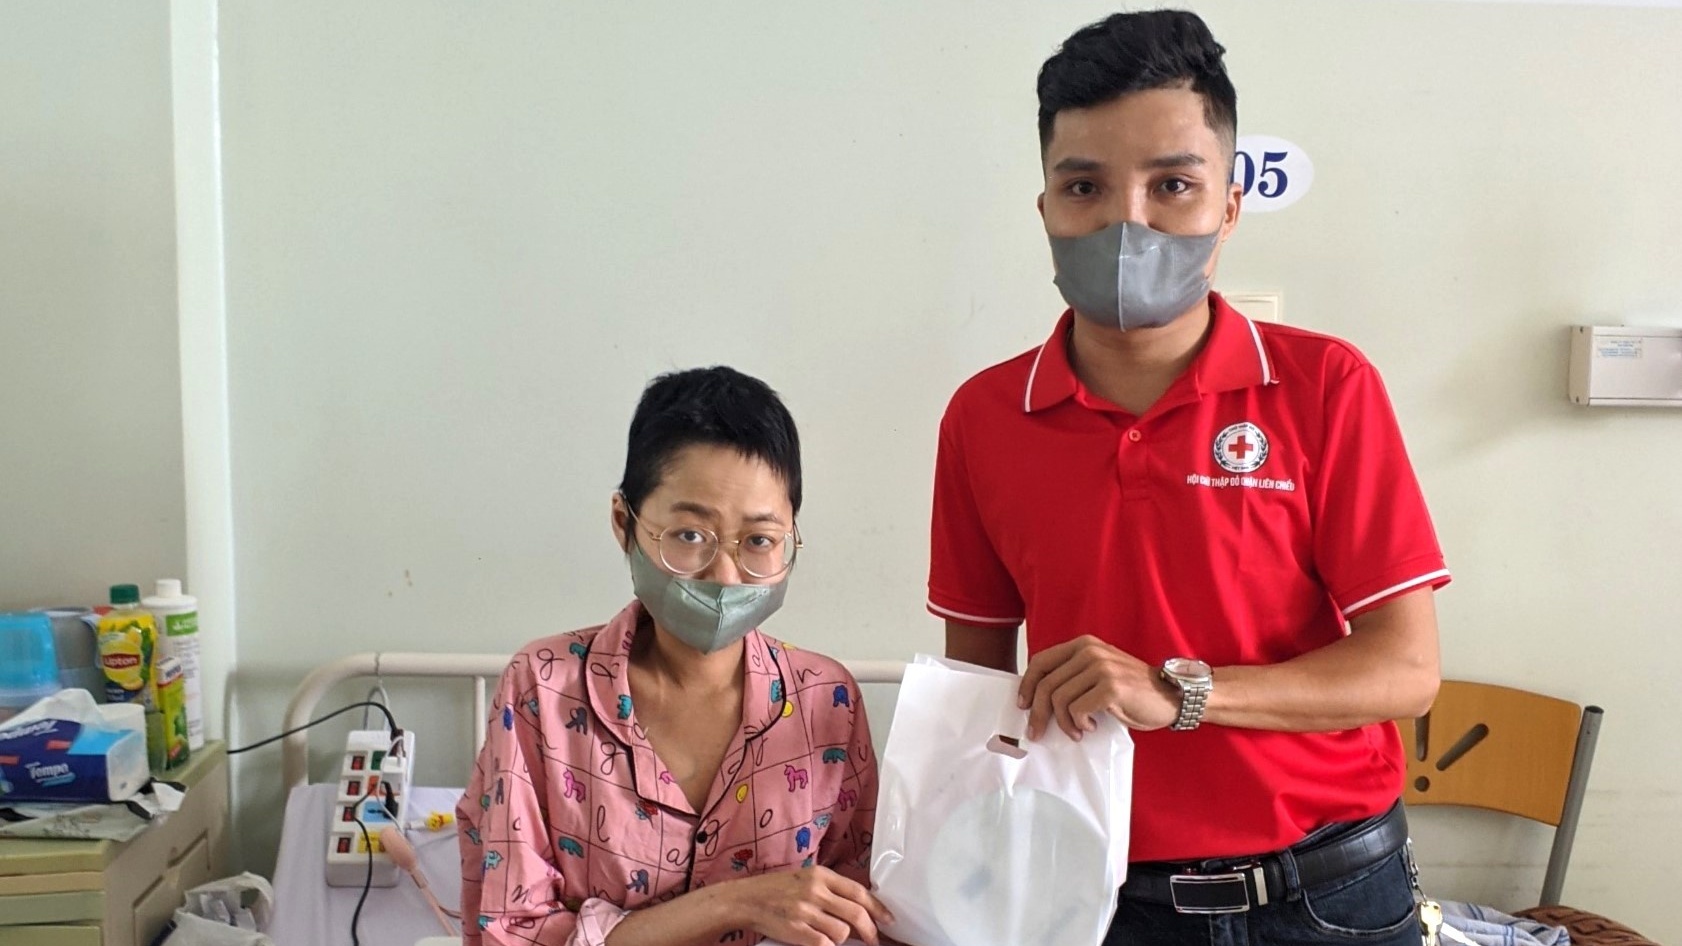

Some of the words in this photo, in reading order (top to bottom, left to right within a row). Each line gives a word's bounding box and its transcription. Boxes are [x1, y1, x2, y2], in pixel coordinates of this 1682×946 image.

[1230, 150, 1288, 198] 05
[103, 656, 138, 668] Lipton
[24, 761, 70, 780] Tempo
